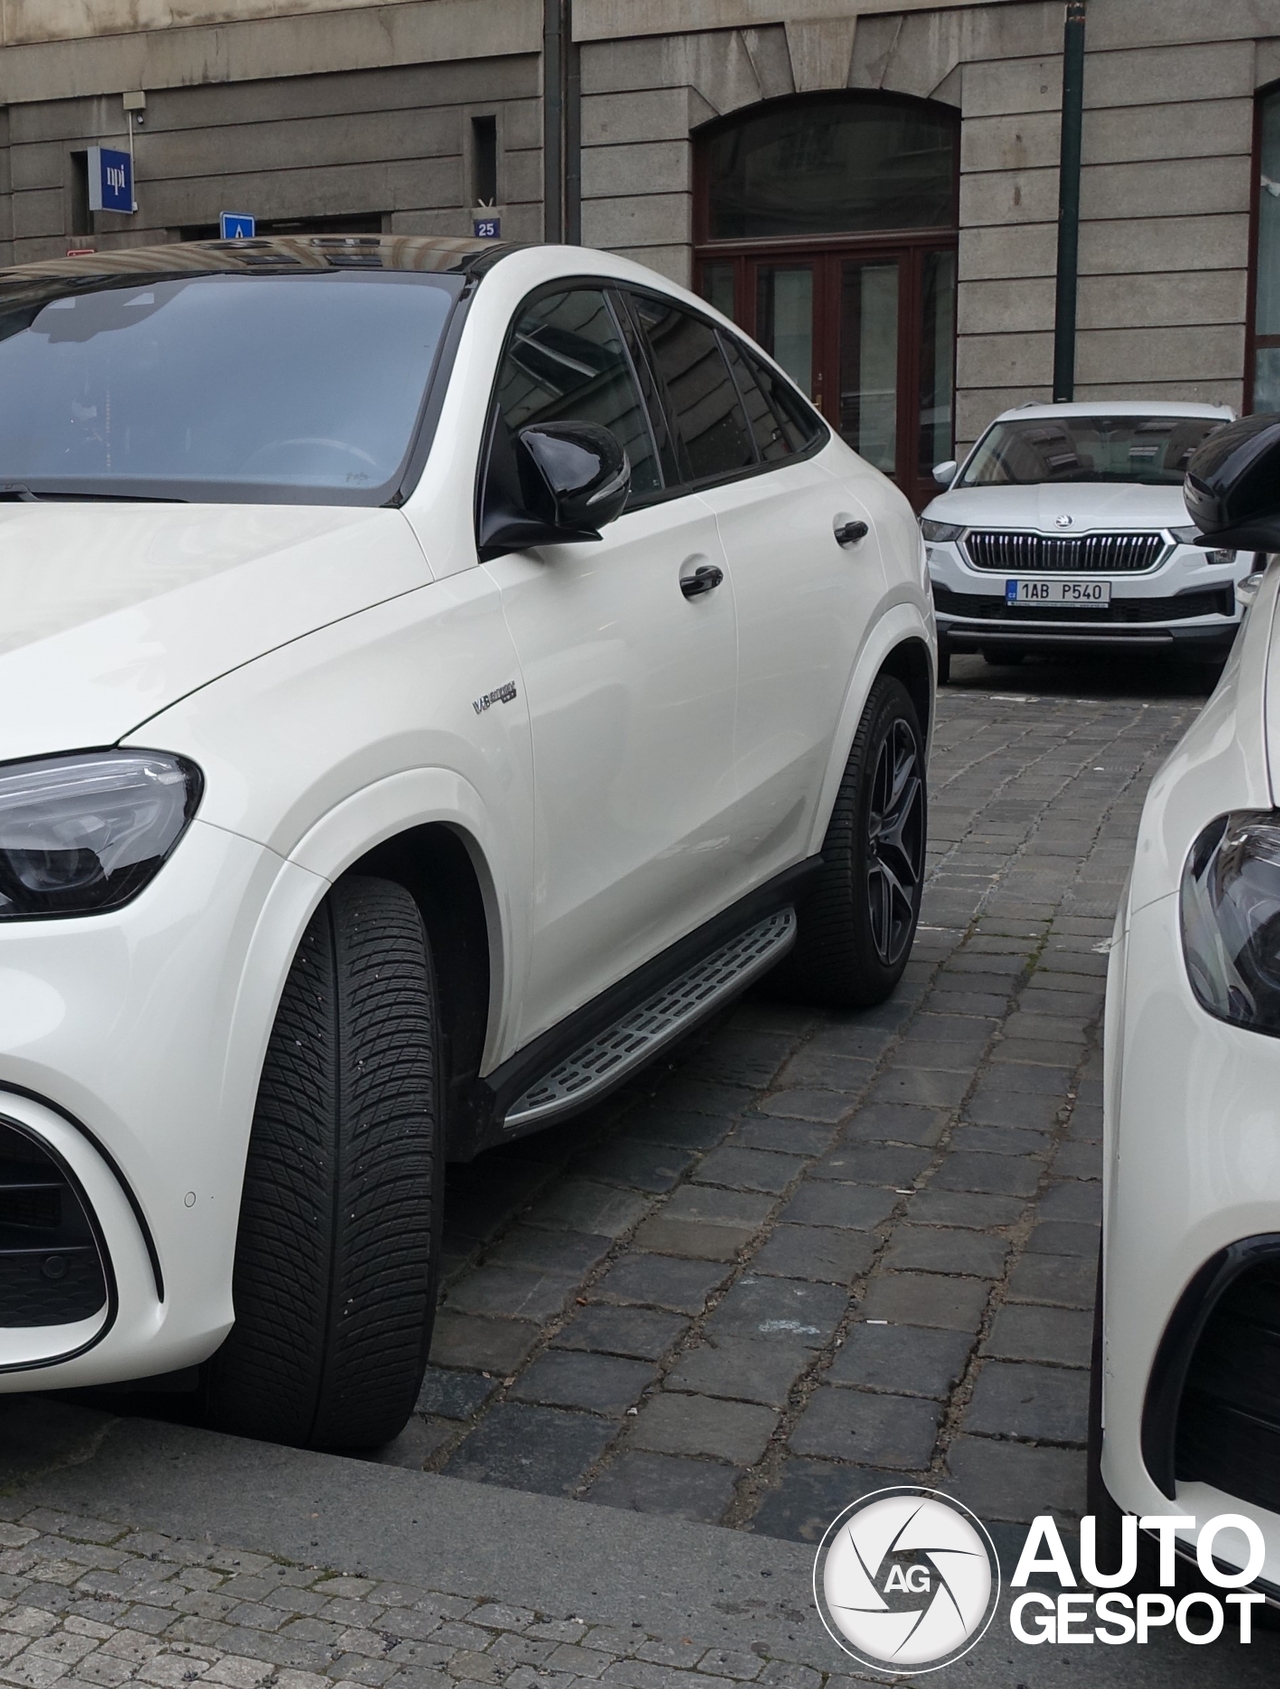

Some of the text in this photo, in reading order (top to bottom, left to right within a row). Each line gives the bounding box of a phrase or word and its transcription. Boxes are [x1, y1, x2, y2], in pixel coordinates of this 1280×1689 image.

[106, 164, 126, 196] npi
[478, 223, 495, 237] 25
[1022, 583, 1102, 600] 1AB P540
